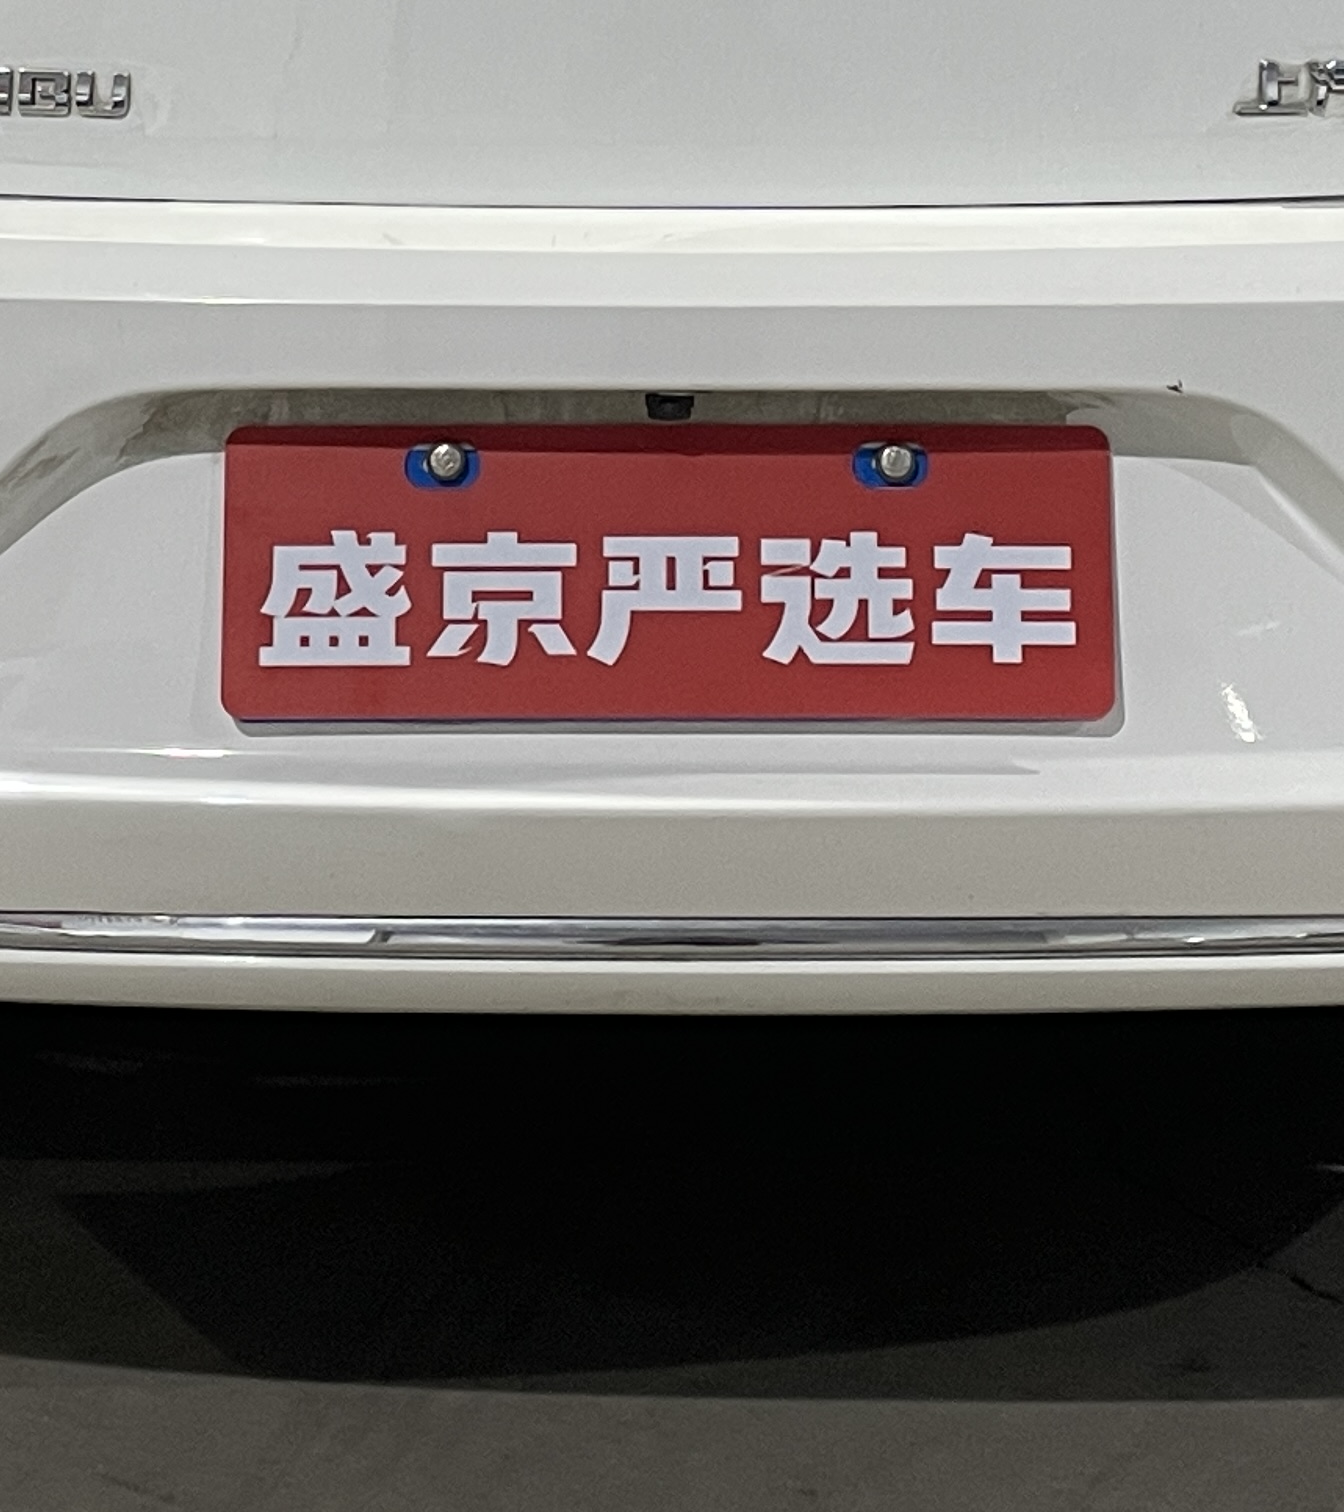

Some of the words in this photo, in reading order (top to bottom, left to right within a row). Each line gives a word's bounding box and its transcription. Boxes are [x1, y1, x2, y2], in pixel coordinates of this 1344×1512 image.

[258, 529, 1078, 667] 盛京严选车
